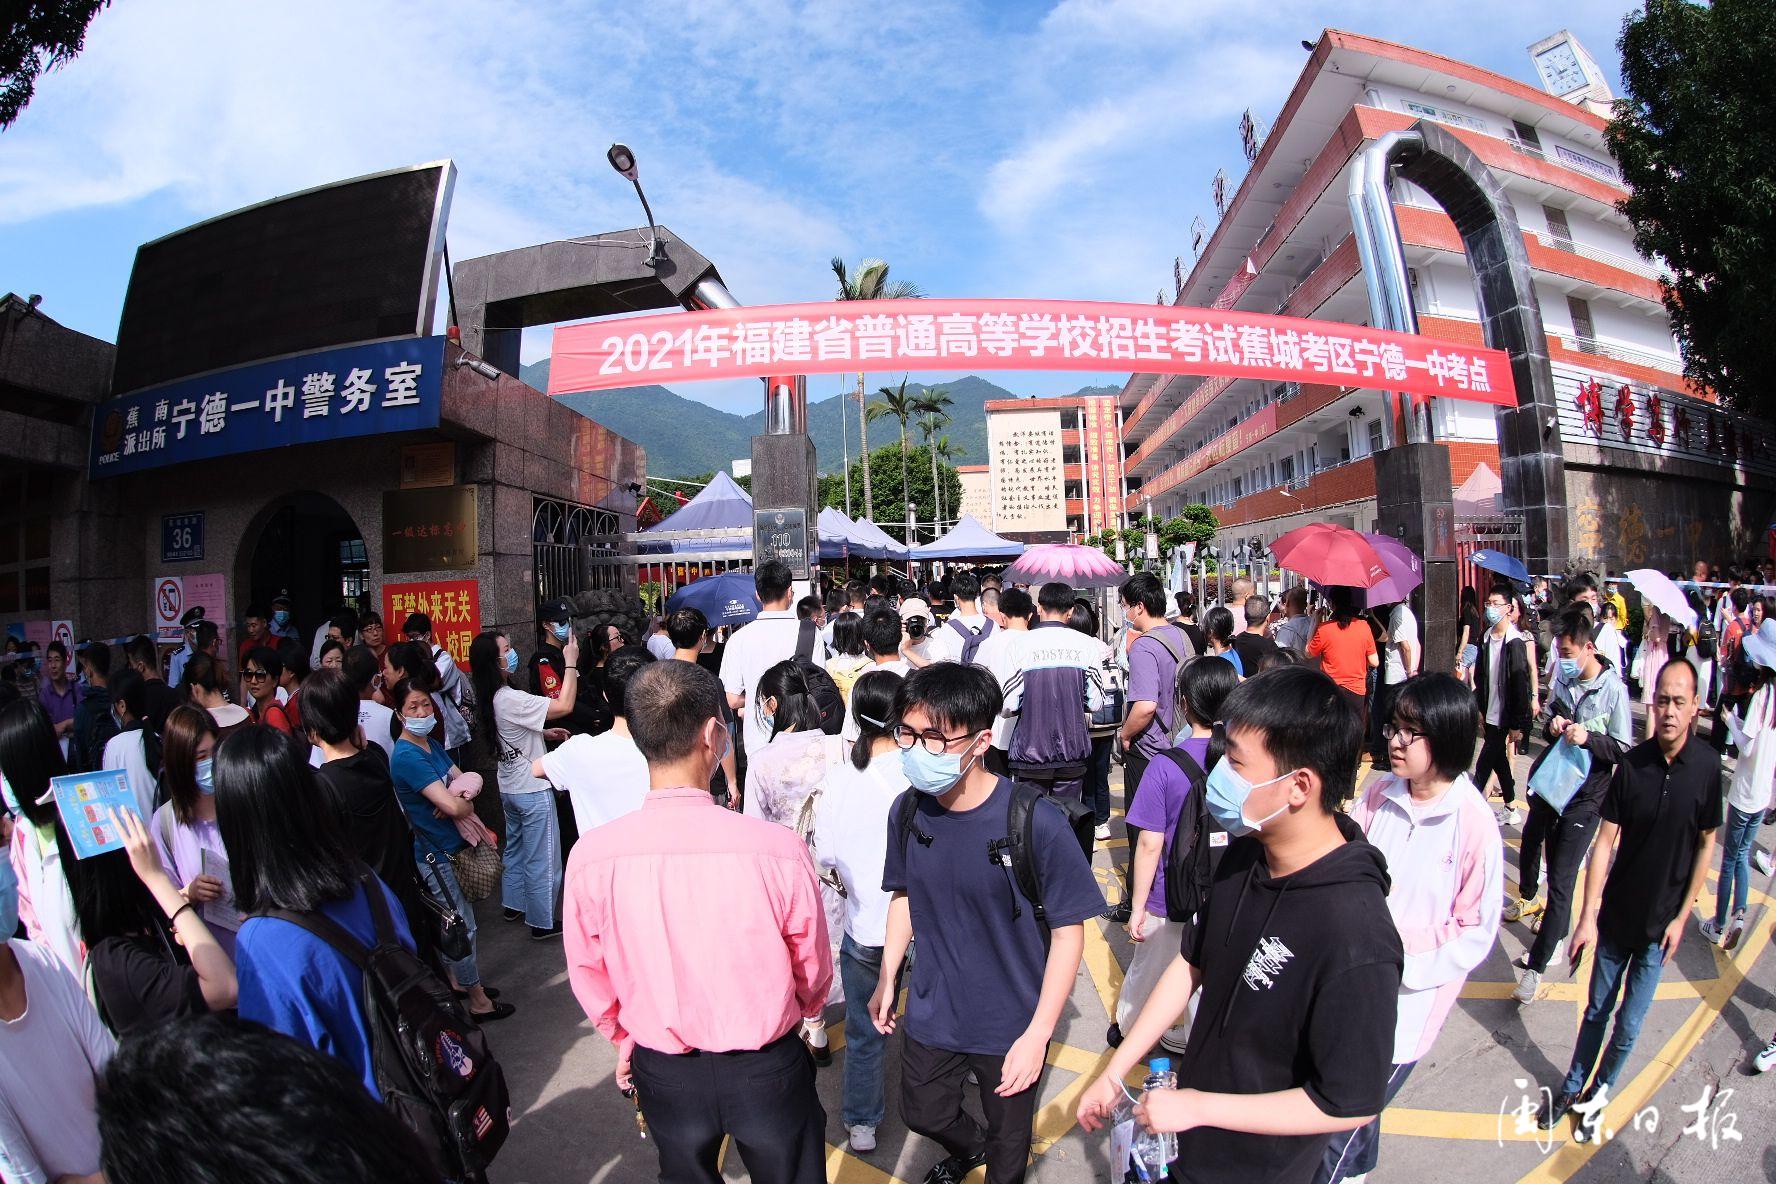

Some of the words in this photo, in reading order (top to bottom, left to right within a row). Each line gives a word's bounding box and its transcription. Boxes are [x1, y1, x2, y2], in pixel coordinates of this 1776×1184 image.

[598, 312, 1491, 393] 2021年福建省普通高等学校招生考试蕉城考区宁德一中考点
[171, 361, 423, 439] 宁德一中警务室
[123, 426, 167, 456] 派出所
[98, 451, 121, 466] POLICE
[172, 527, 192, 549] 36
[391, 519, 467, 538] 一级达标高中
[391, 589, 472, 625] 严禁外来无关
